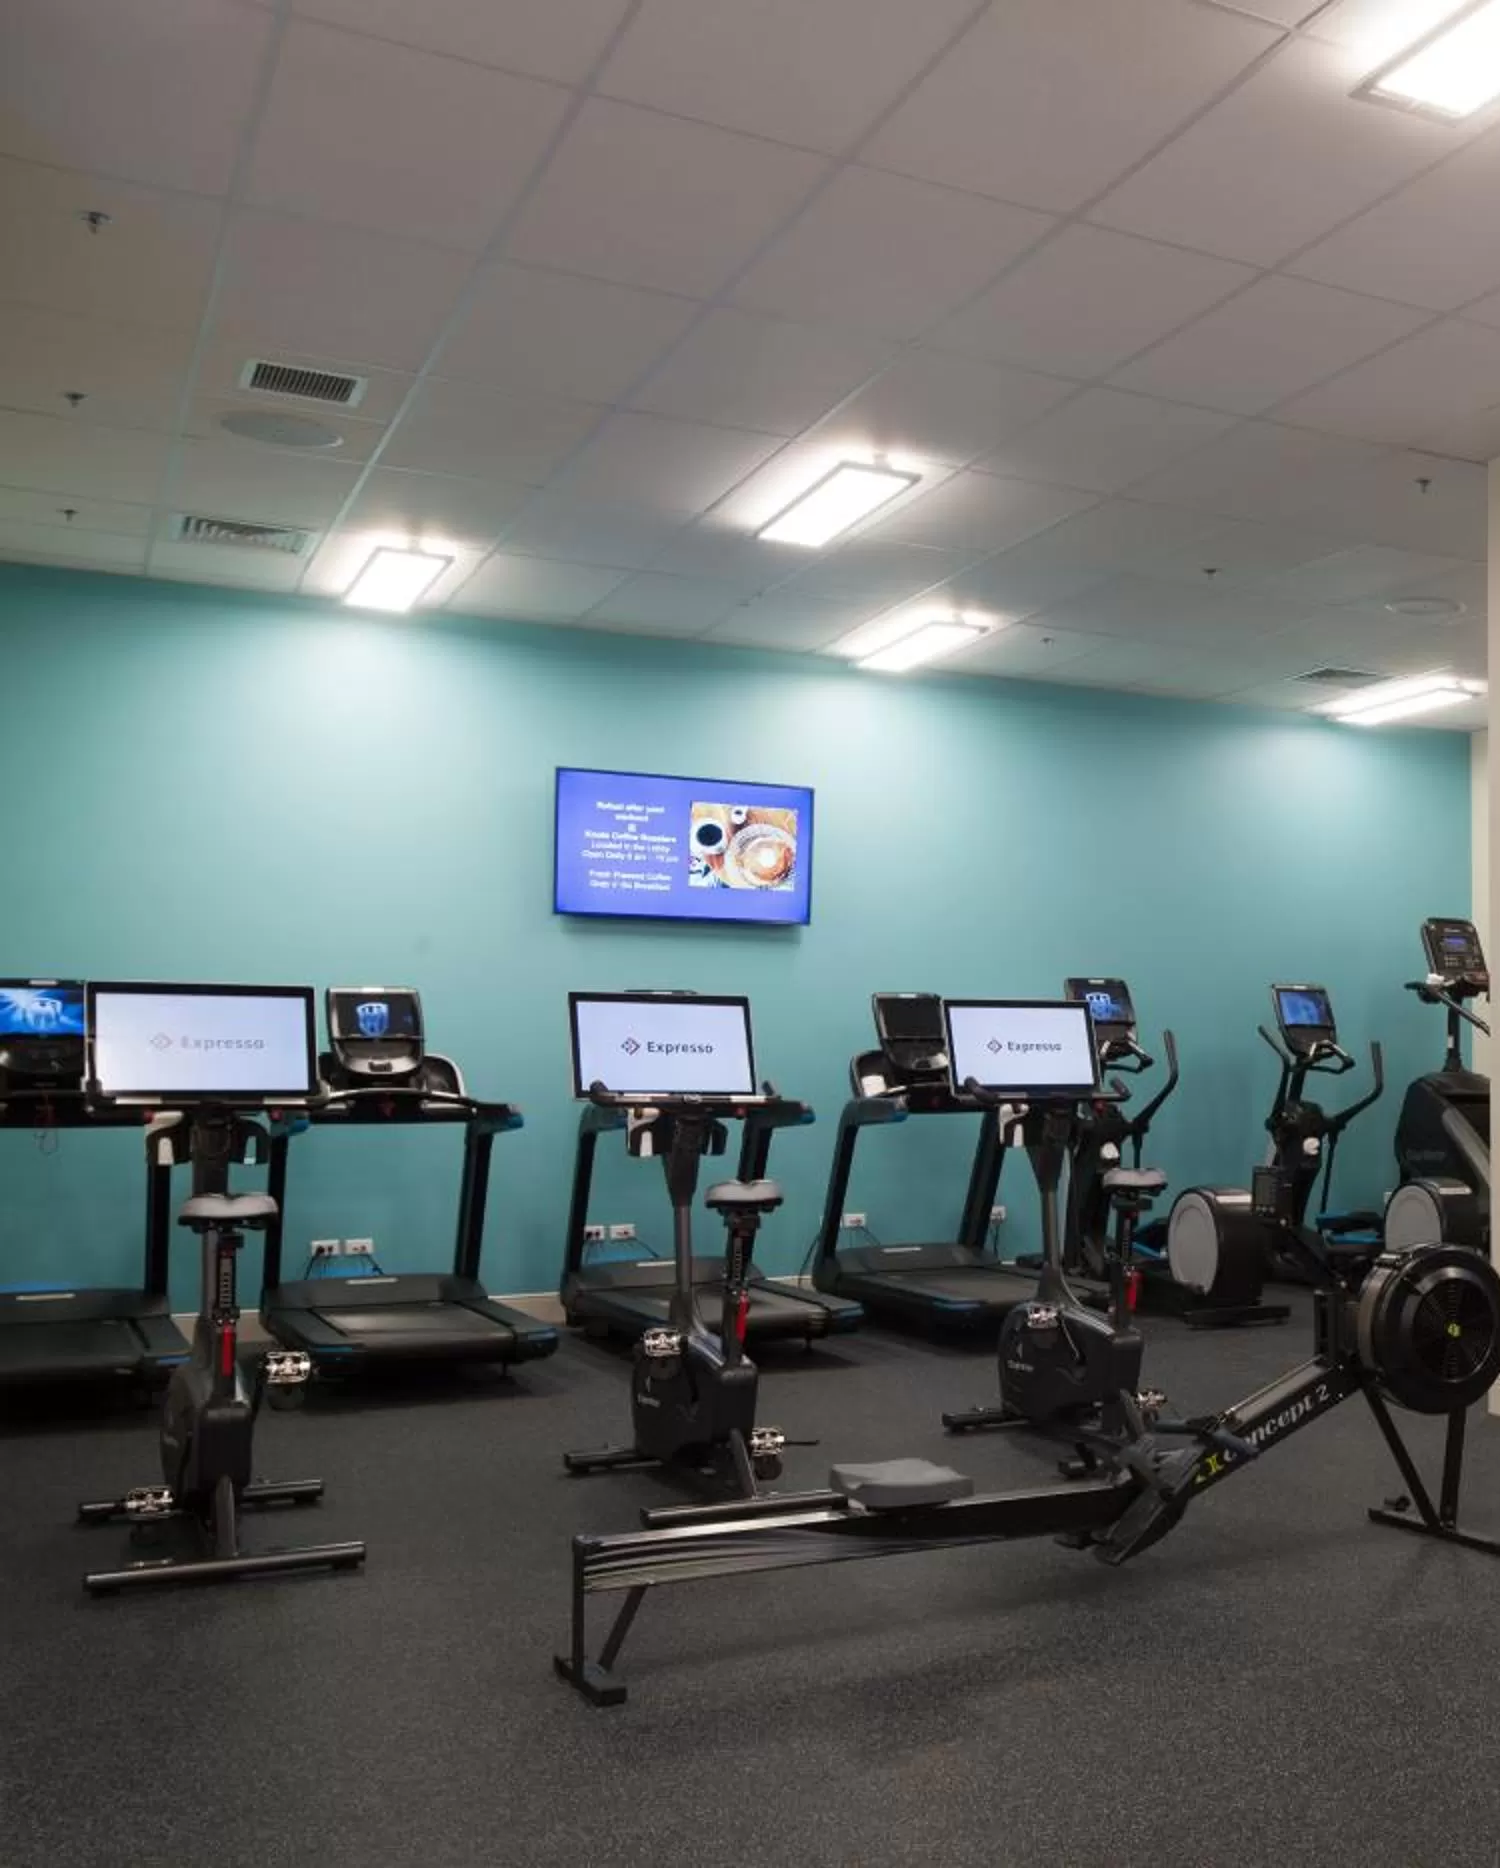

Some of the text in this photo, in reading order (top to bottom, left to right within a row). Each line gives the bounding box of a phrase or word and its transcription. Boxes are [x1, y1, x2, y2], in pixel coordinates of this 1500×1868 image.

[180, 1035, 266, 1051] Expresso
[647, 1041, 714, 1056] Expresso
[1007, 1041, 1062, 1053] Expresso
[1316, 1383, 1330, 1402] 2
